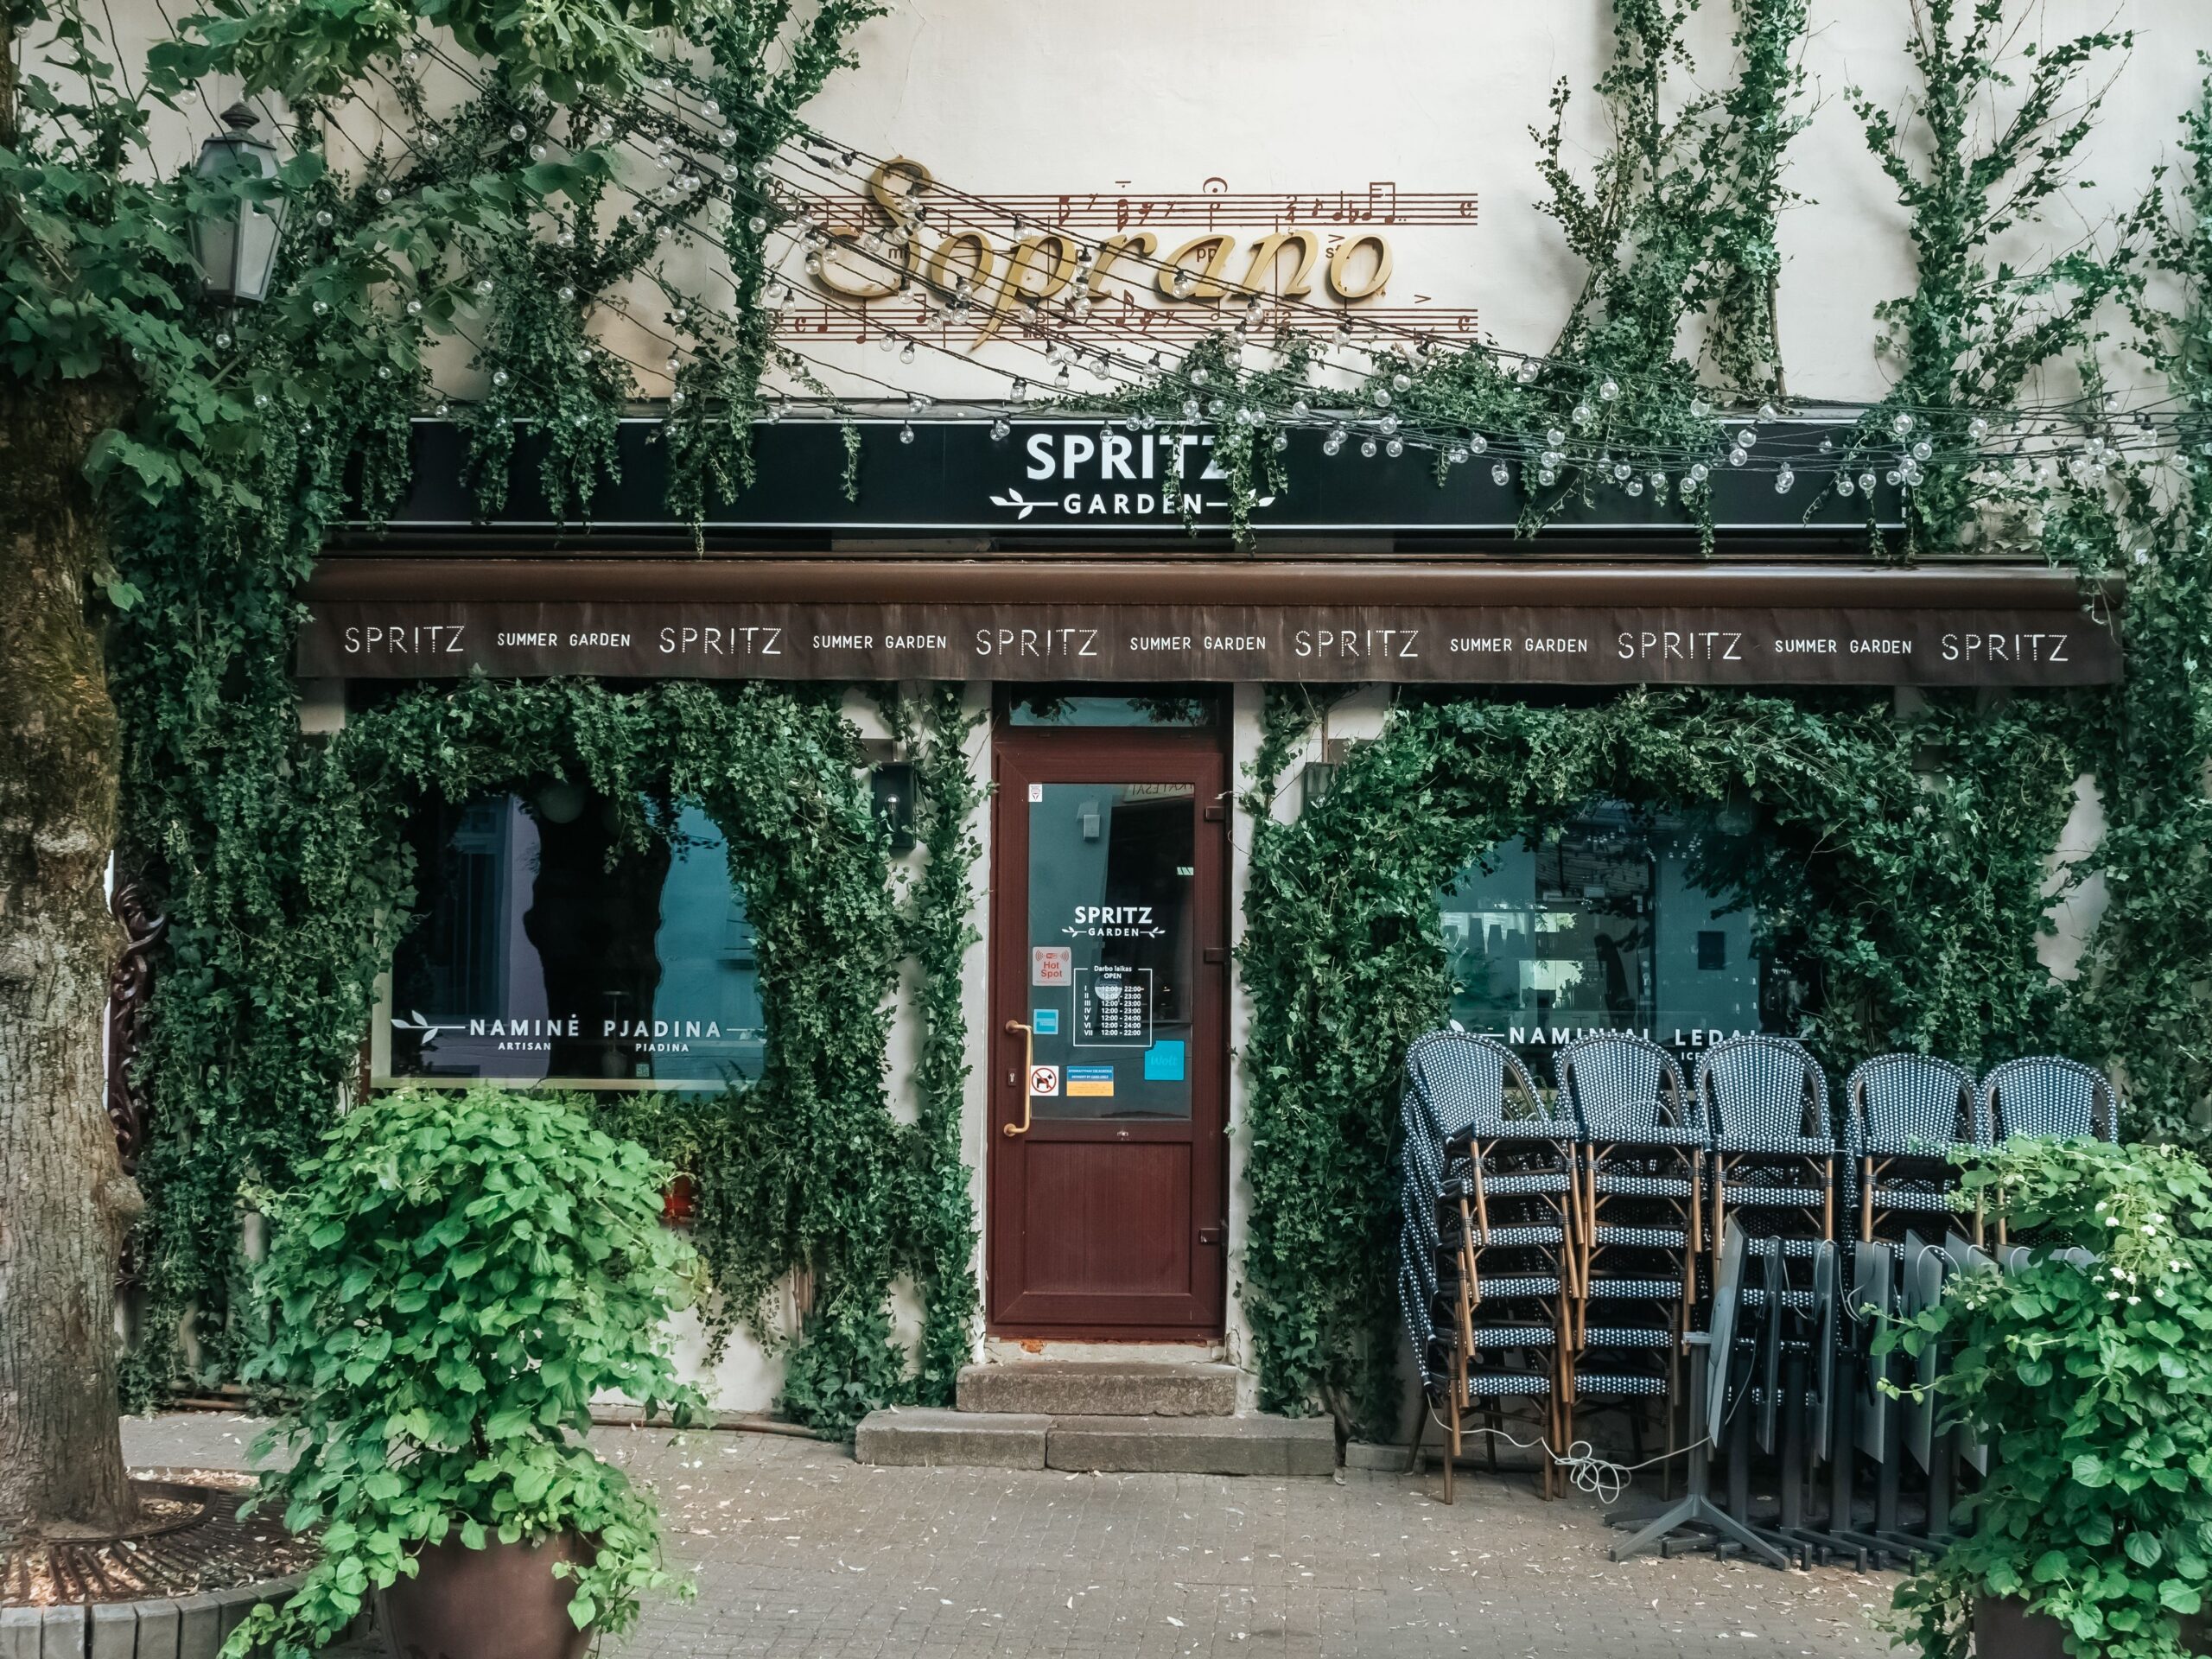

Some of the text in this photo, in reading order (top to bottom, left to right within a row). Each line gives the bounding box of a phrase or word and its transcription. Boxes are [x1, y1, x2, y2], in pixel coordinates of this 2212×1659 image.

[817, 158, 1393, 351] Soprano
[1064, 493, 1202, 515] GARDEN
[345, 626, 2069, 662] SPRITZ SUMMER GARDEN SPRITZ SUMMER GARDEN SPRITZ SUMMER GARDEN SPRITZ SUMMER GARDEN SPRITZ SUMMER GARDEN SPRITZ
[1074, 906, 1153, 925] SPRITZ
[1088, 927, 1139, 937] GARDEN
[1040, 969, 1063, 979] Spot
[470, 1014, 721, 1038] NAMINĖ PJADINA
[498, 1041, 690, 1052] ARTISAN PIADINA
[1150, 1055, 1179, 1066] Wolt
